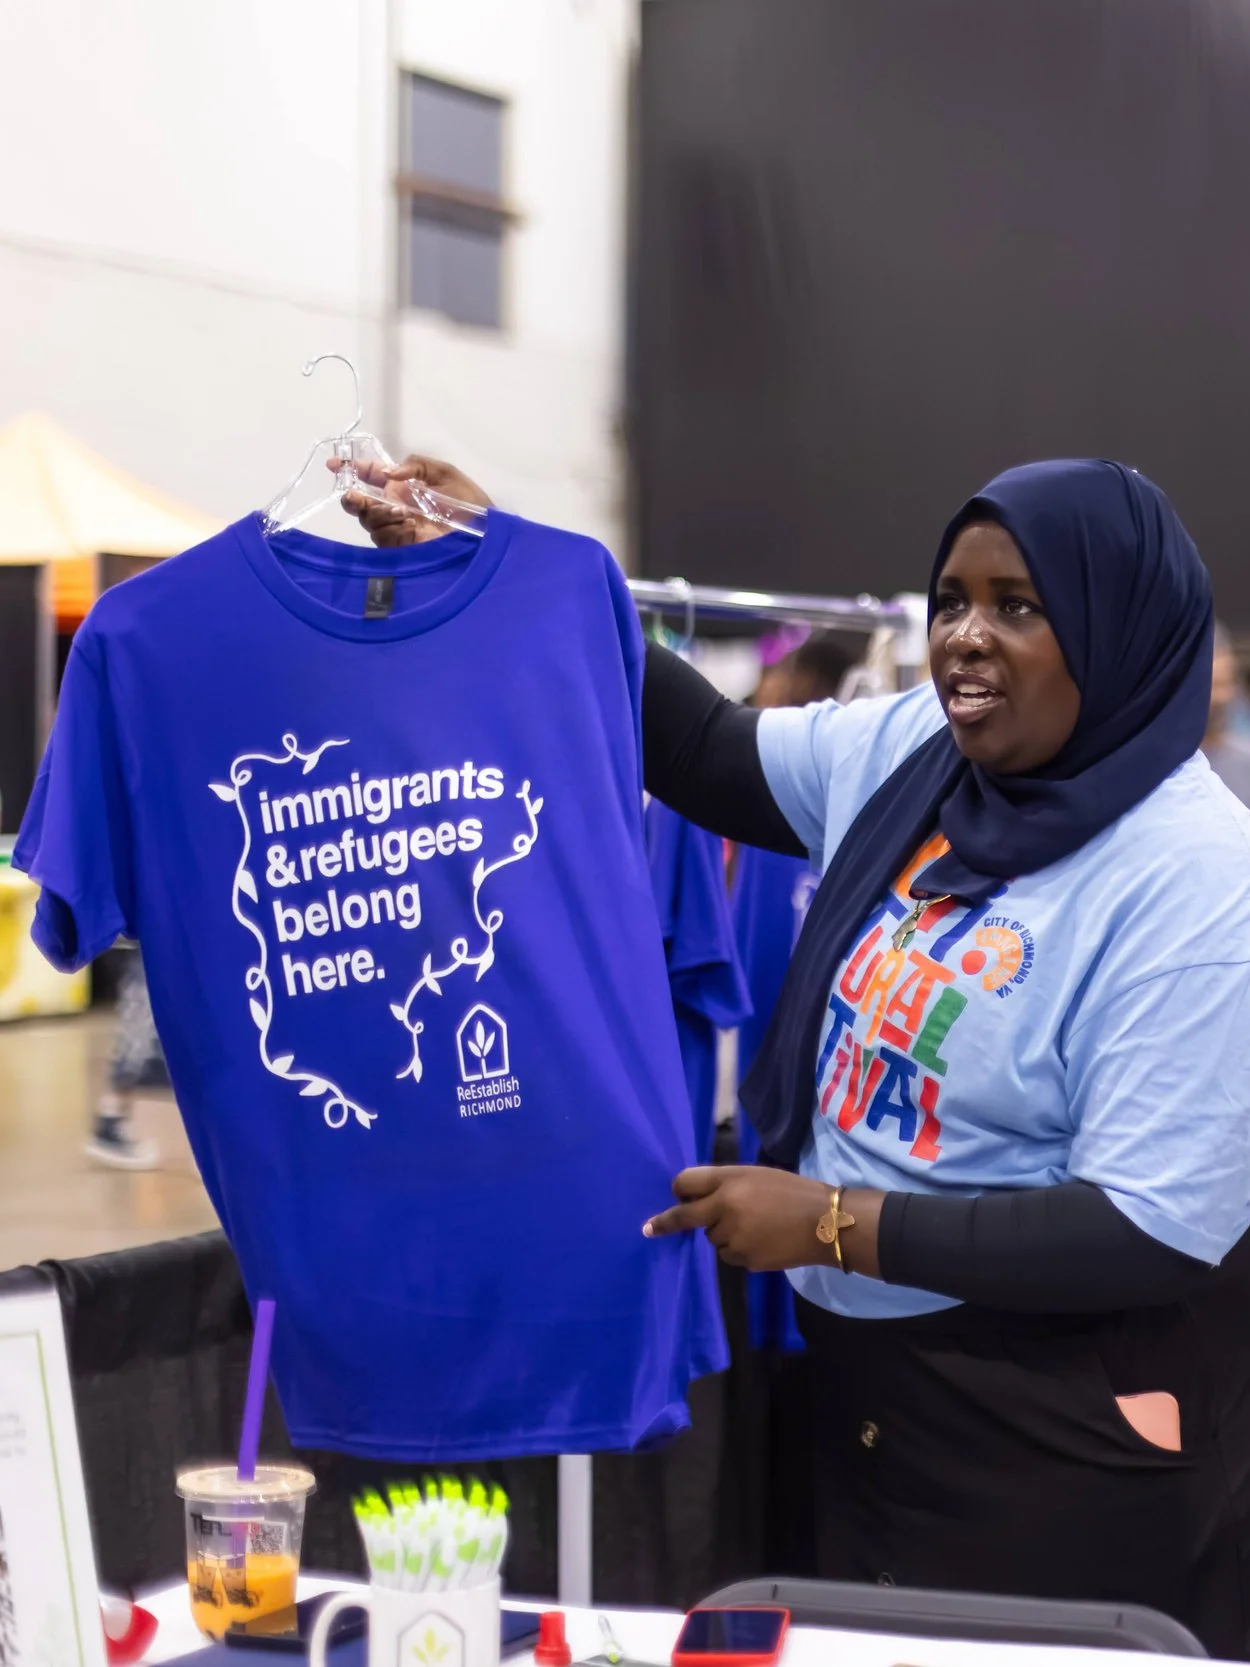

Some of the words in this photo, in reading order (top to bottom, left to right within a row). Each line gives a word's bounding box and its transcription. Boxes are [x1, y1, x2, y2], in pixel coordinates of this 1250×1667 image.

[258, 761, 505, 835] immigrants
[272, 883, 422, 943] belong
[983, 917, 1010, 928] CITY
[1010, 921, 1025, 933] OF
[281, 949, 386, 997] here.
[995, 984, 1013, 999] VA
[456, 1076, 520, 1102] ReEstablish
[460, 1095, 522, 1118] RICHMOND
